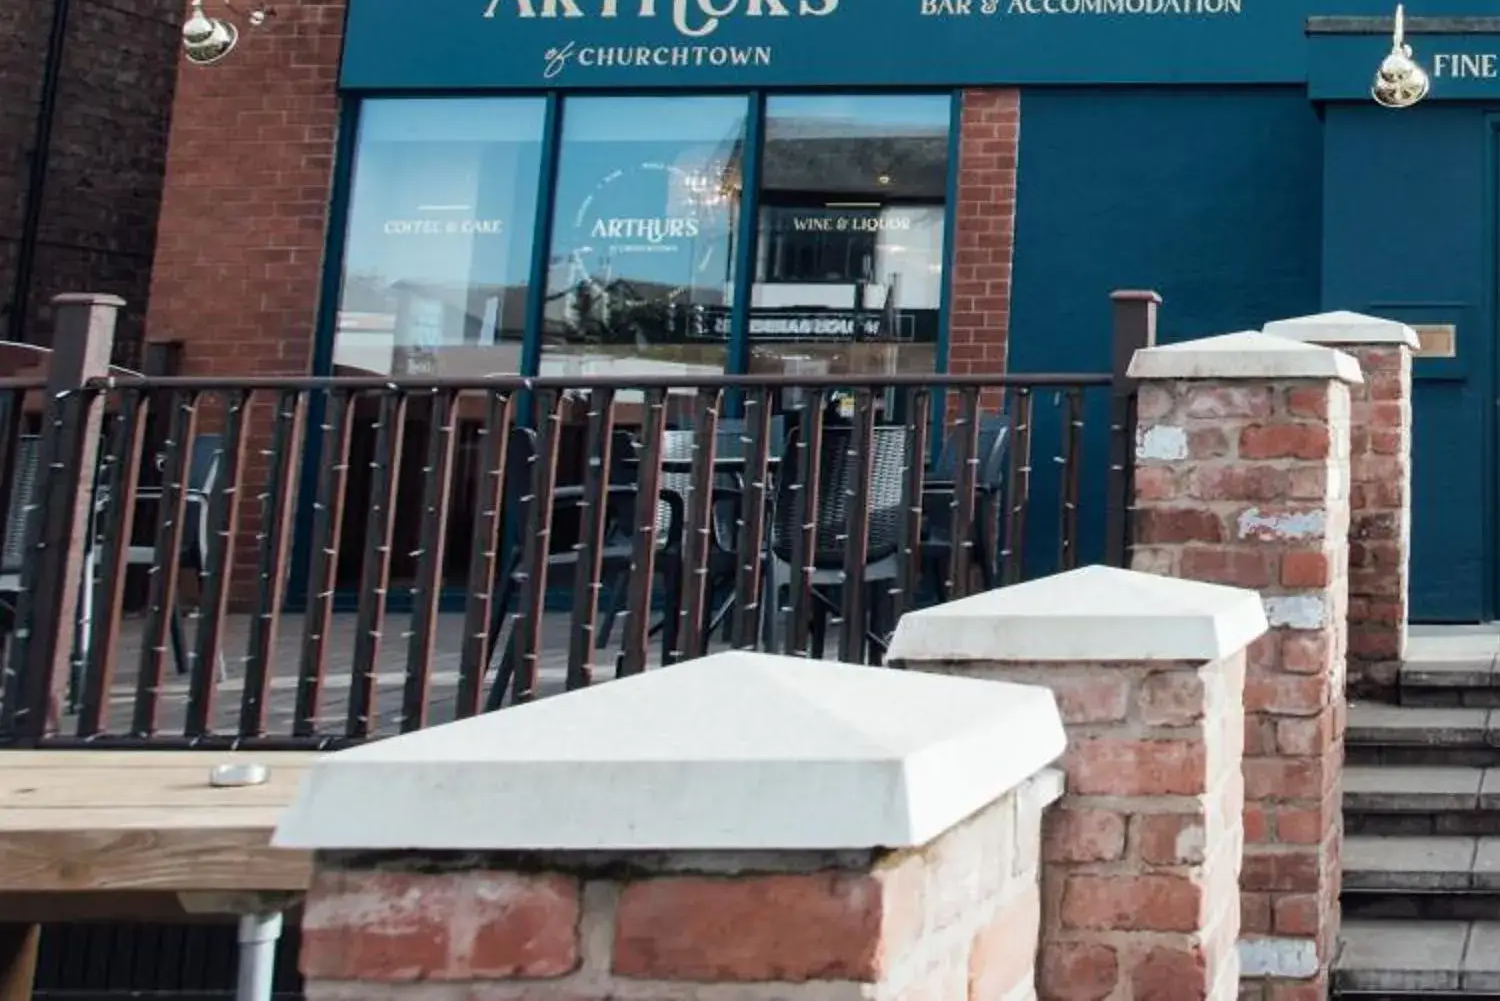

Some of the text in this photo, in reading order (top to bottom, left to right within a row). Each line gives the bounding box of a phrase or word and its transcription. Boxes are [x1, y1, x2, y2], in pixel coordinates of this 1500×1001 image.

[543, 41, 772, 79] of CHURCHTOWN
[1433, 54, 1498, 78] FINE
[793, 216, 832, 231] WINE
